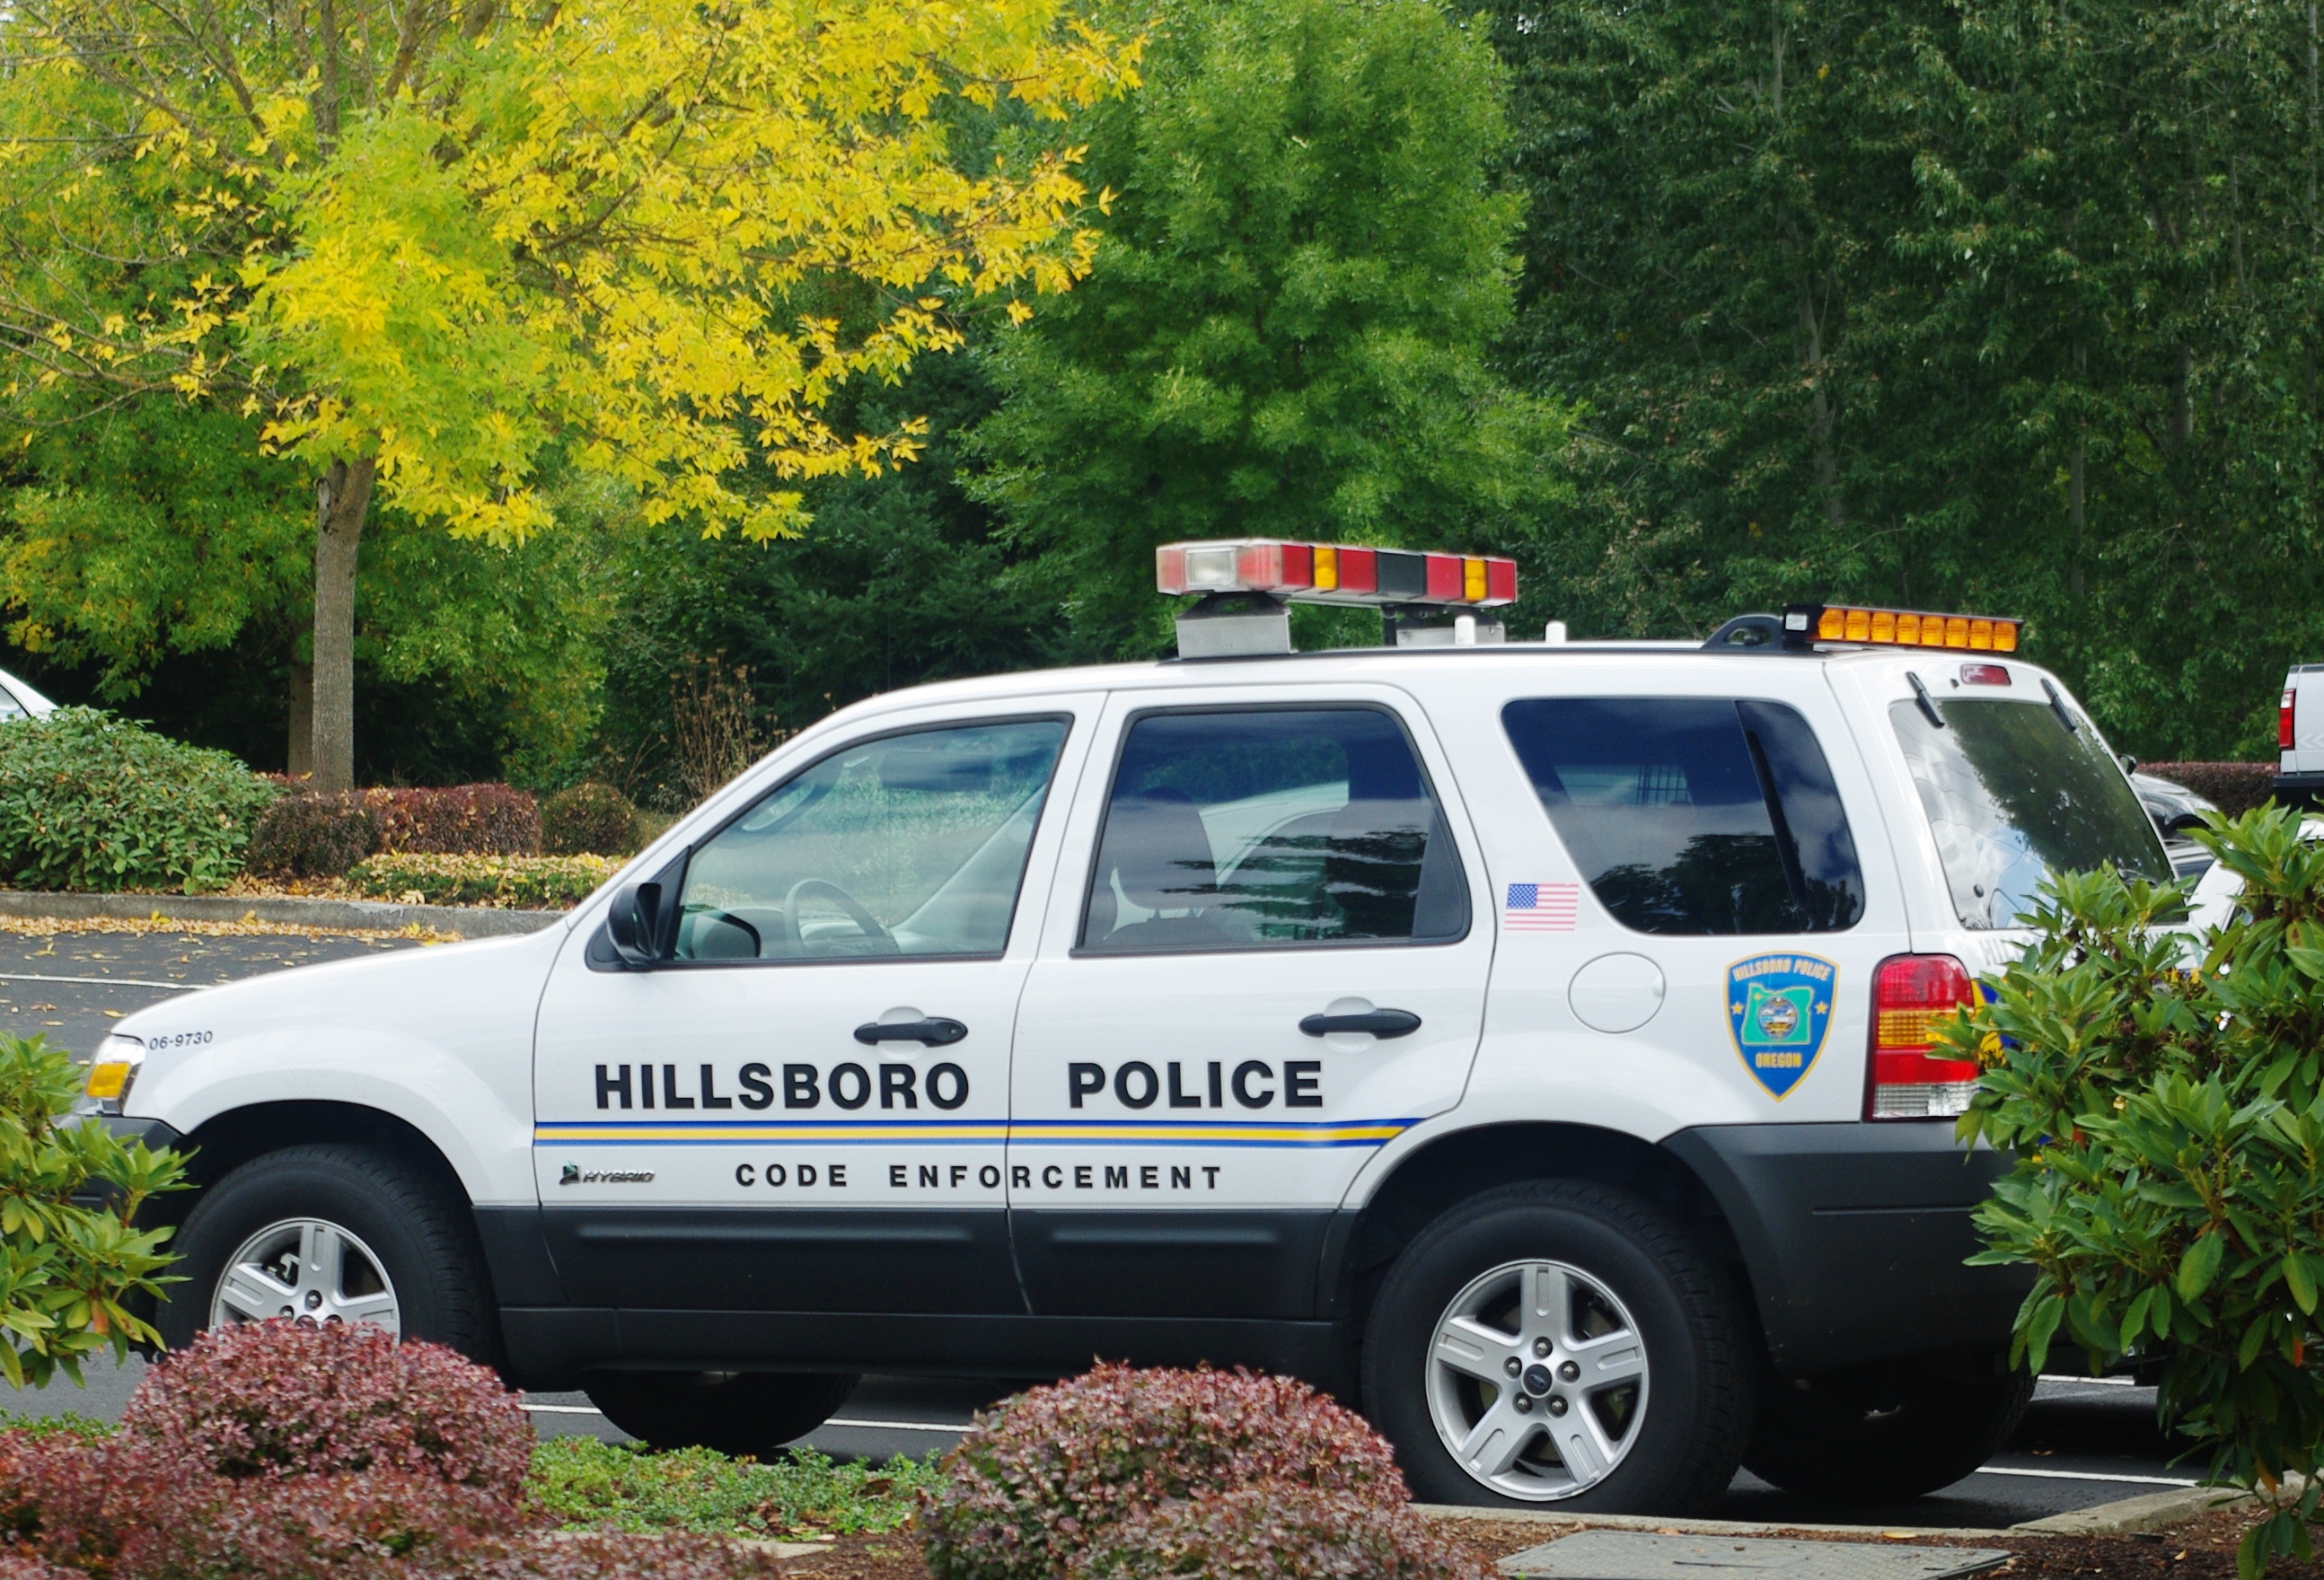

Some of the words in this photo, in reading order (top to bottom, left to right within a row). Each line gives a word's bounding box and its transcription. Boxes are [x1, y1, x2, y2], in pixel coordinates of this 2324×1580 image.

[1732, 958, 1791, 982] HILLSBORO
[1793, 959, 1832, 981] POLICE
[149, 1030, 213, 1050] 06-9730
[1756, 1052, 1802, 1068] OREGON
[594, 1062, 970, 1110] HILLSBORO
[1068, 1059, 1324, 1110] POLICE
[583, 1170, 656, 1183] HYBRID
[735, 1163, 847, 1188] CODE
[888, 1164, 1220, 1189] ENFORCEMENT
